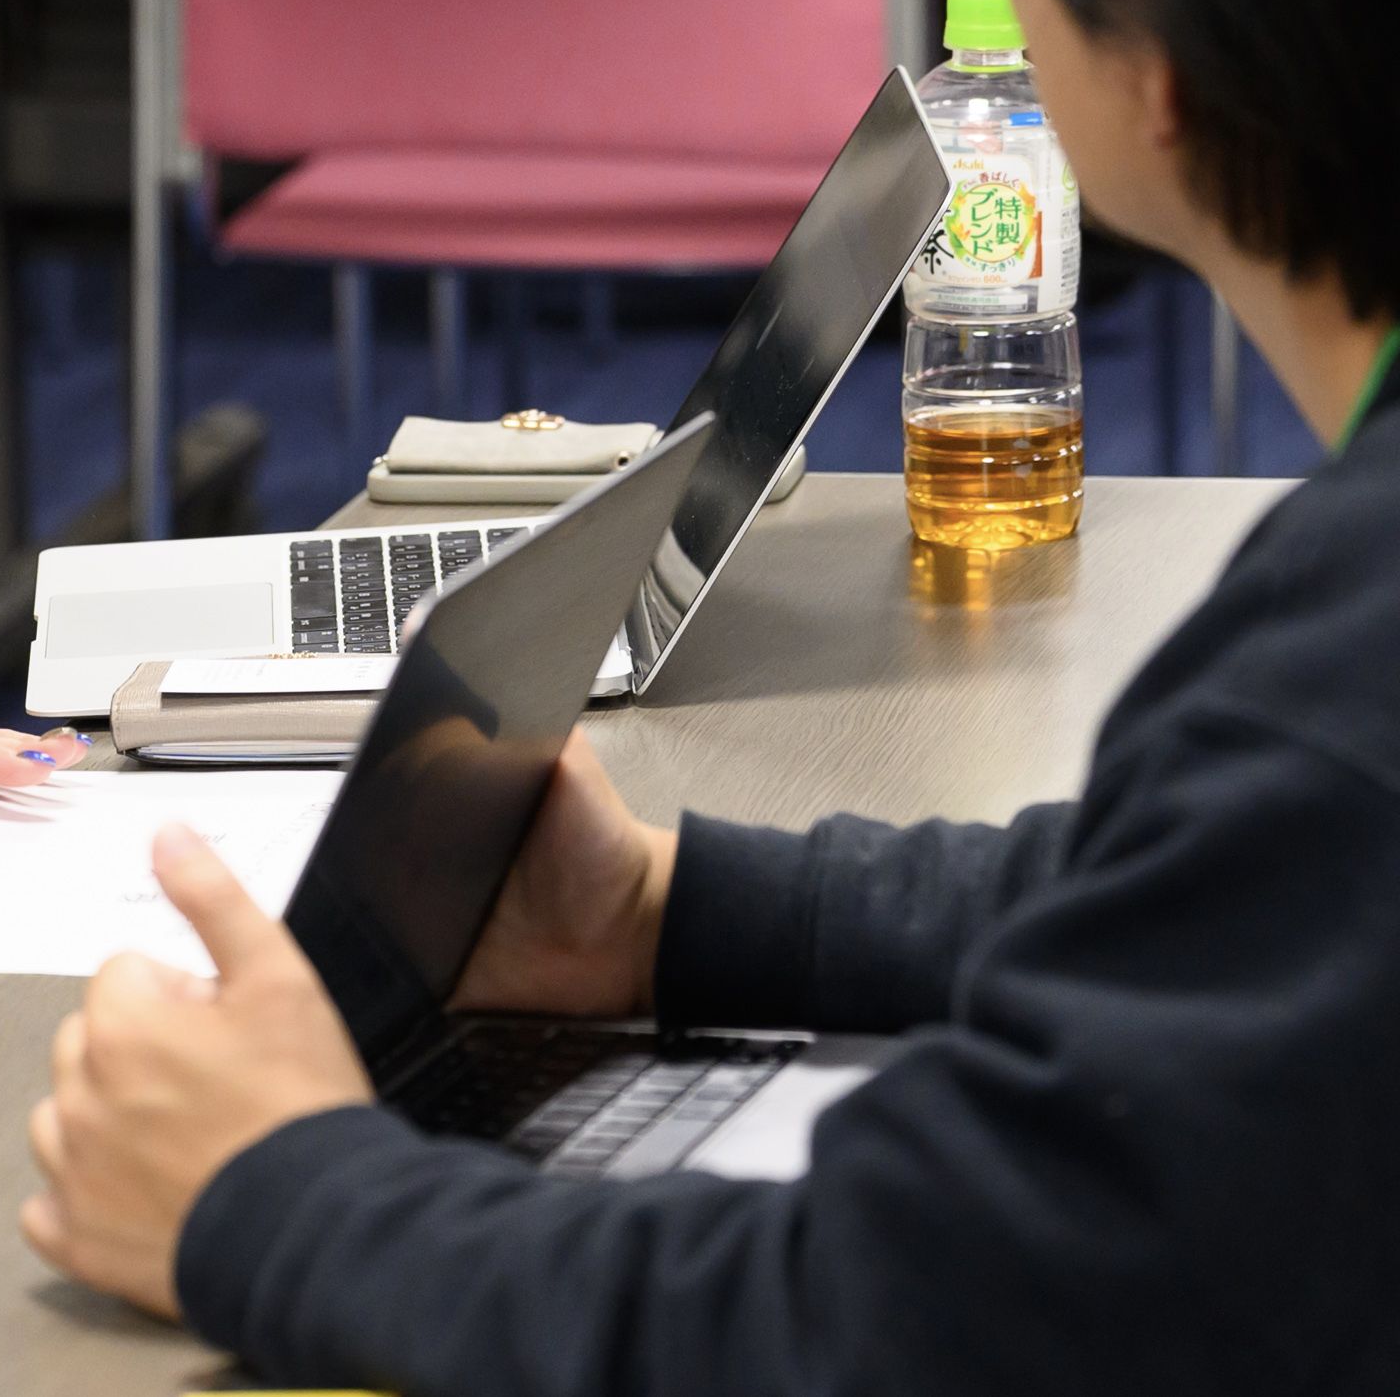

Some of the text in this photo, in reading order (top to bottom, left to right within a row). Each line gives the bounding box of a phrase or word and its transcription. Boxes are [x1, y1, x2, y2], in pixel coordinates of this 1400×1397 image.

[953, 159, 984, 170] Asahi
[968, 188, 998, 256] ブレンド
[995, 197, 1021, 245] 特製
